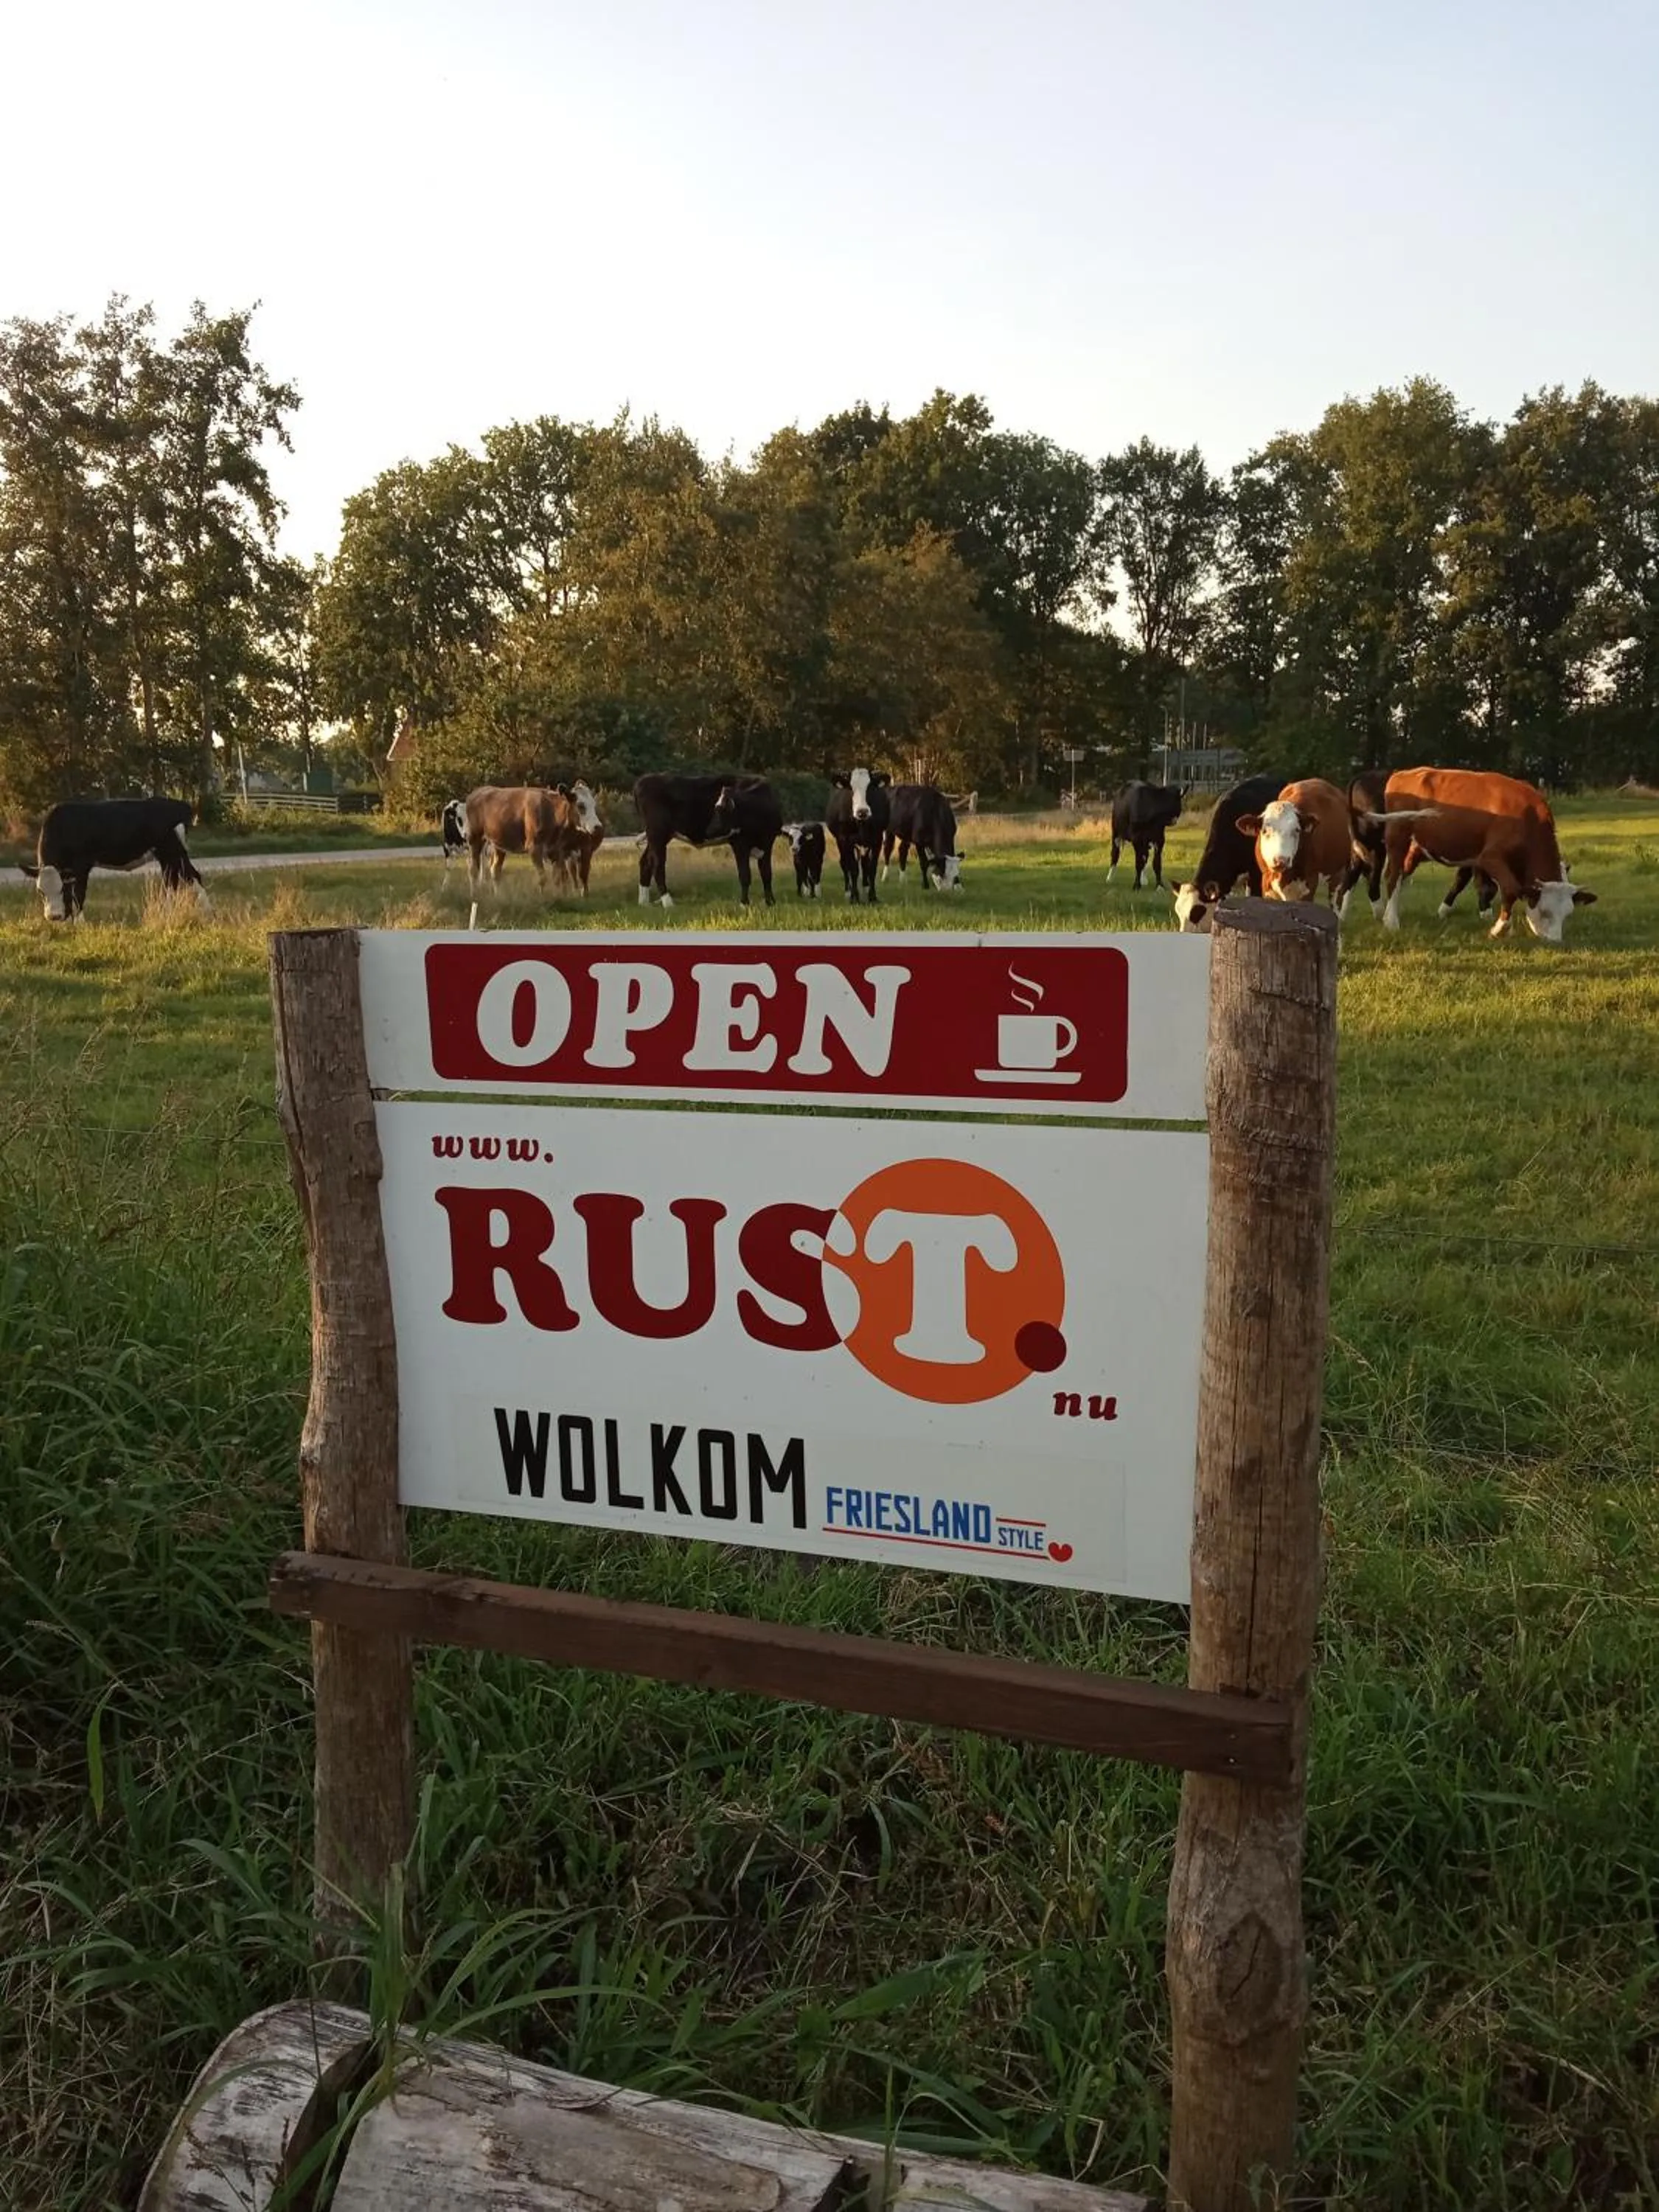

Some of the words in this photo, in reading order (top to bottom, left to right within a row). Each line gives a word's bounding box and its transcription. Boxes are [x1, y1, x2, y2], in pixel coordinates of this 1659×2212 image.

[476, 960, 911, 1077] OPEN
[431, 1134, 554, 1164] www.
[1053, 1391, 1119, 1421] nu
[494, 1408, 807, 1528] WOLKOM
[826, 1486, 991, 1543] FRIESLAND
[998, 1527, 1044, 1551] STYLE
